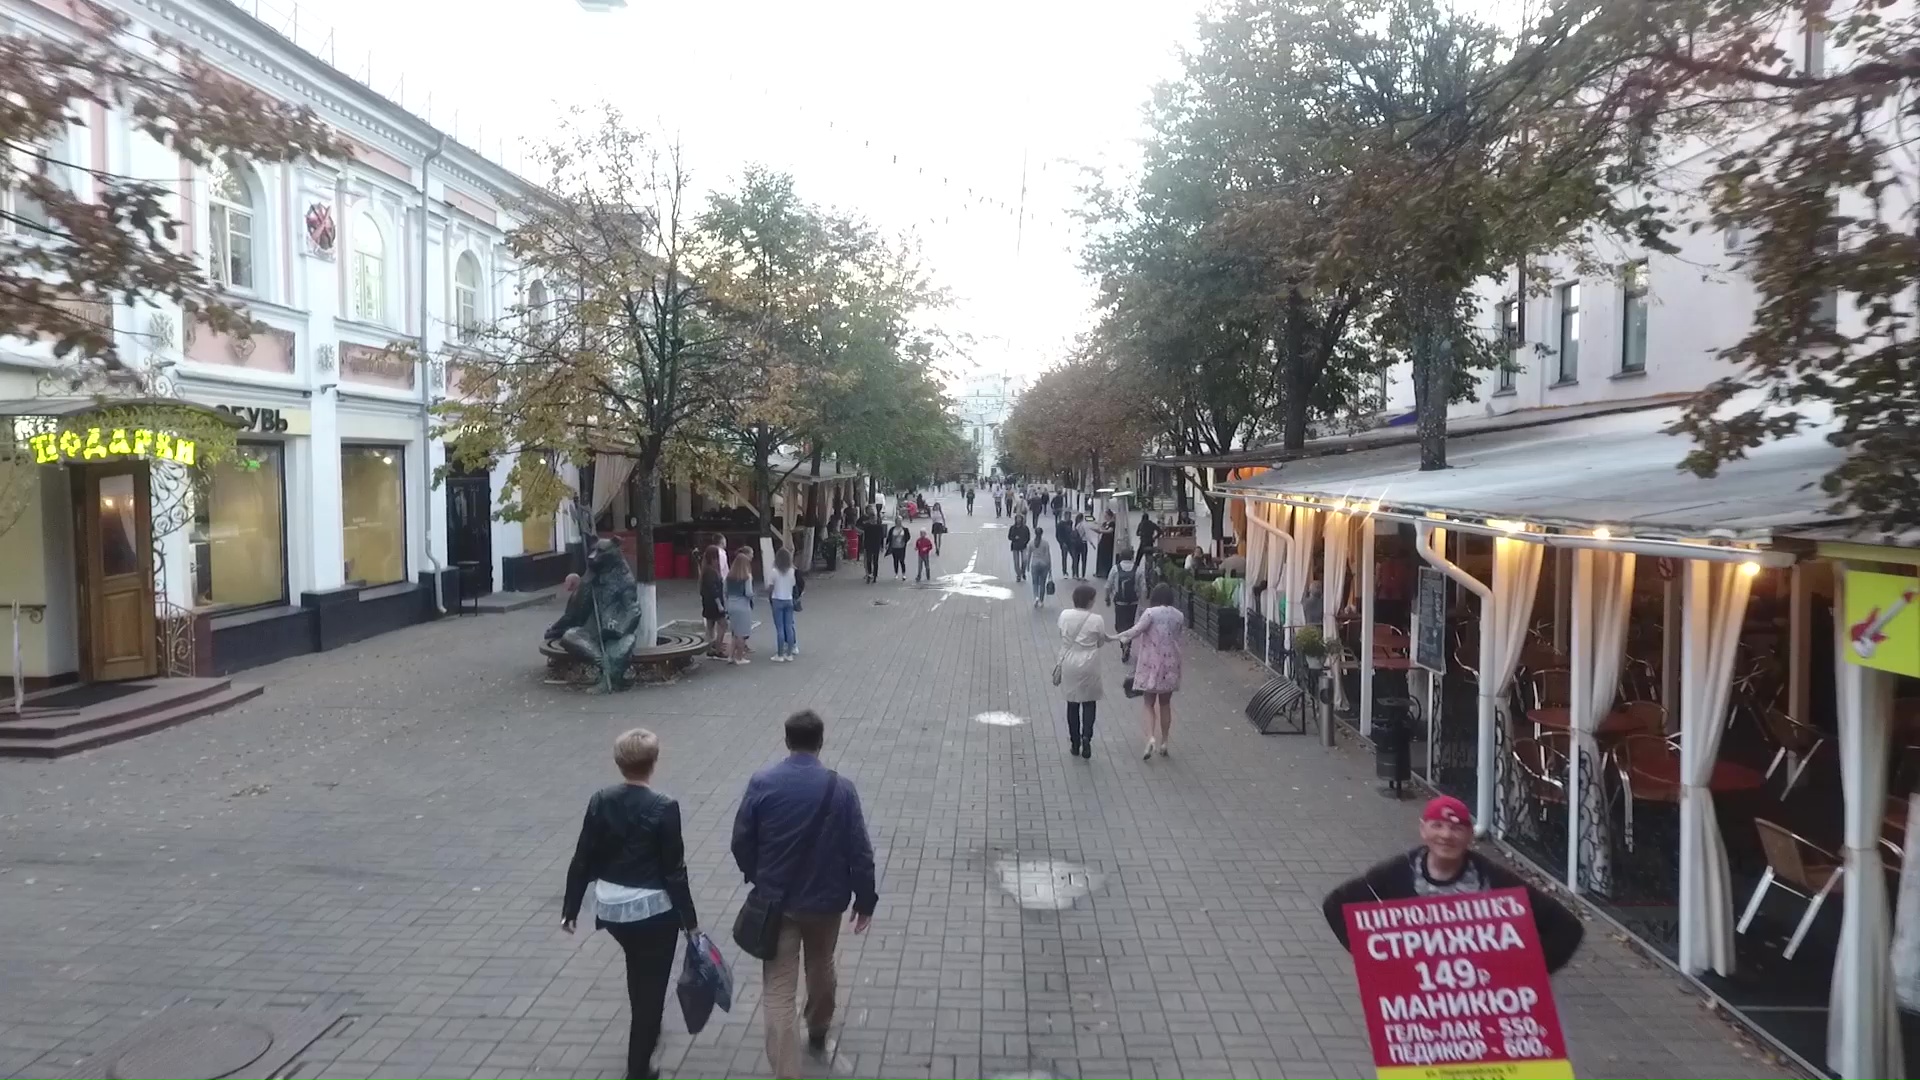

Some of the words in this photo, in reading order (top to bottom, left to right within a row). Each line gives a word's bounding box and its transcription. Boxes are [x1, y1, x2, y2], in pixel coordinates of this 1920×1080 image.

[29, 427, 195, 465] ПОДАРКИ
[1354, 896, 1526, 932] ЦИРЮЛЬНИКЪ
[1367, 922, 1526, 961] СТРИЖКА
[1378, 986, 1538, 1021] МАНИКЮР
[1384, 1019, 1484, 1044] ГЕЛЬ-ЛАК
[1388, 1039, 1488, 1066] ПЕДИКЮР
